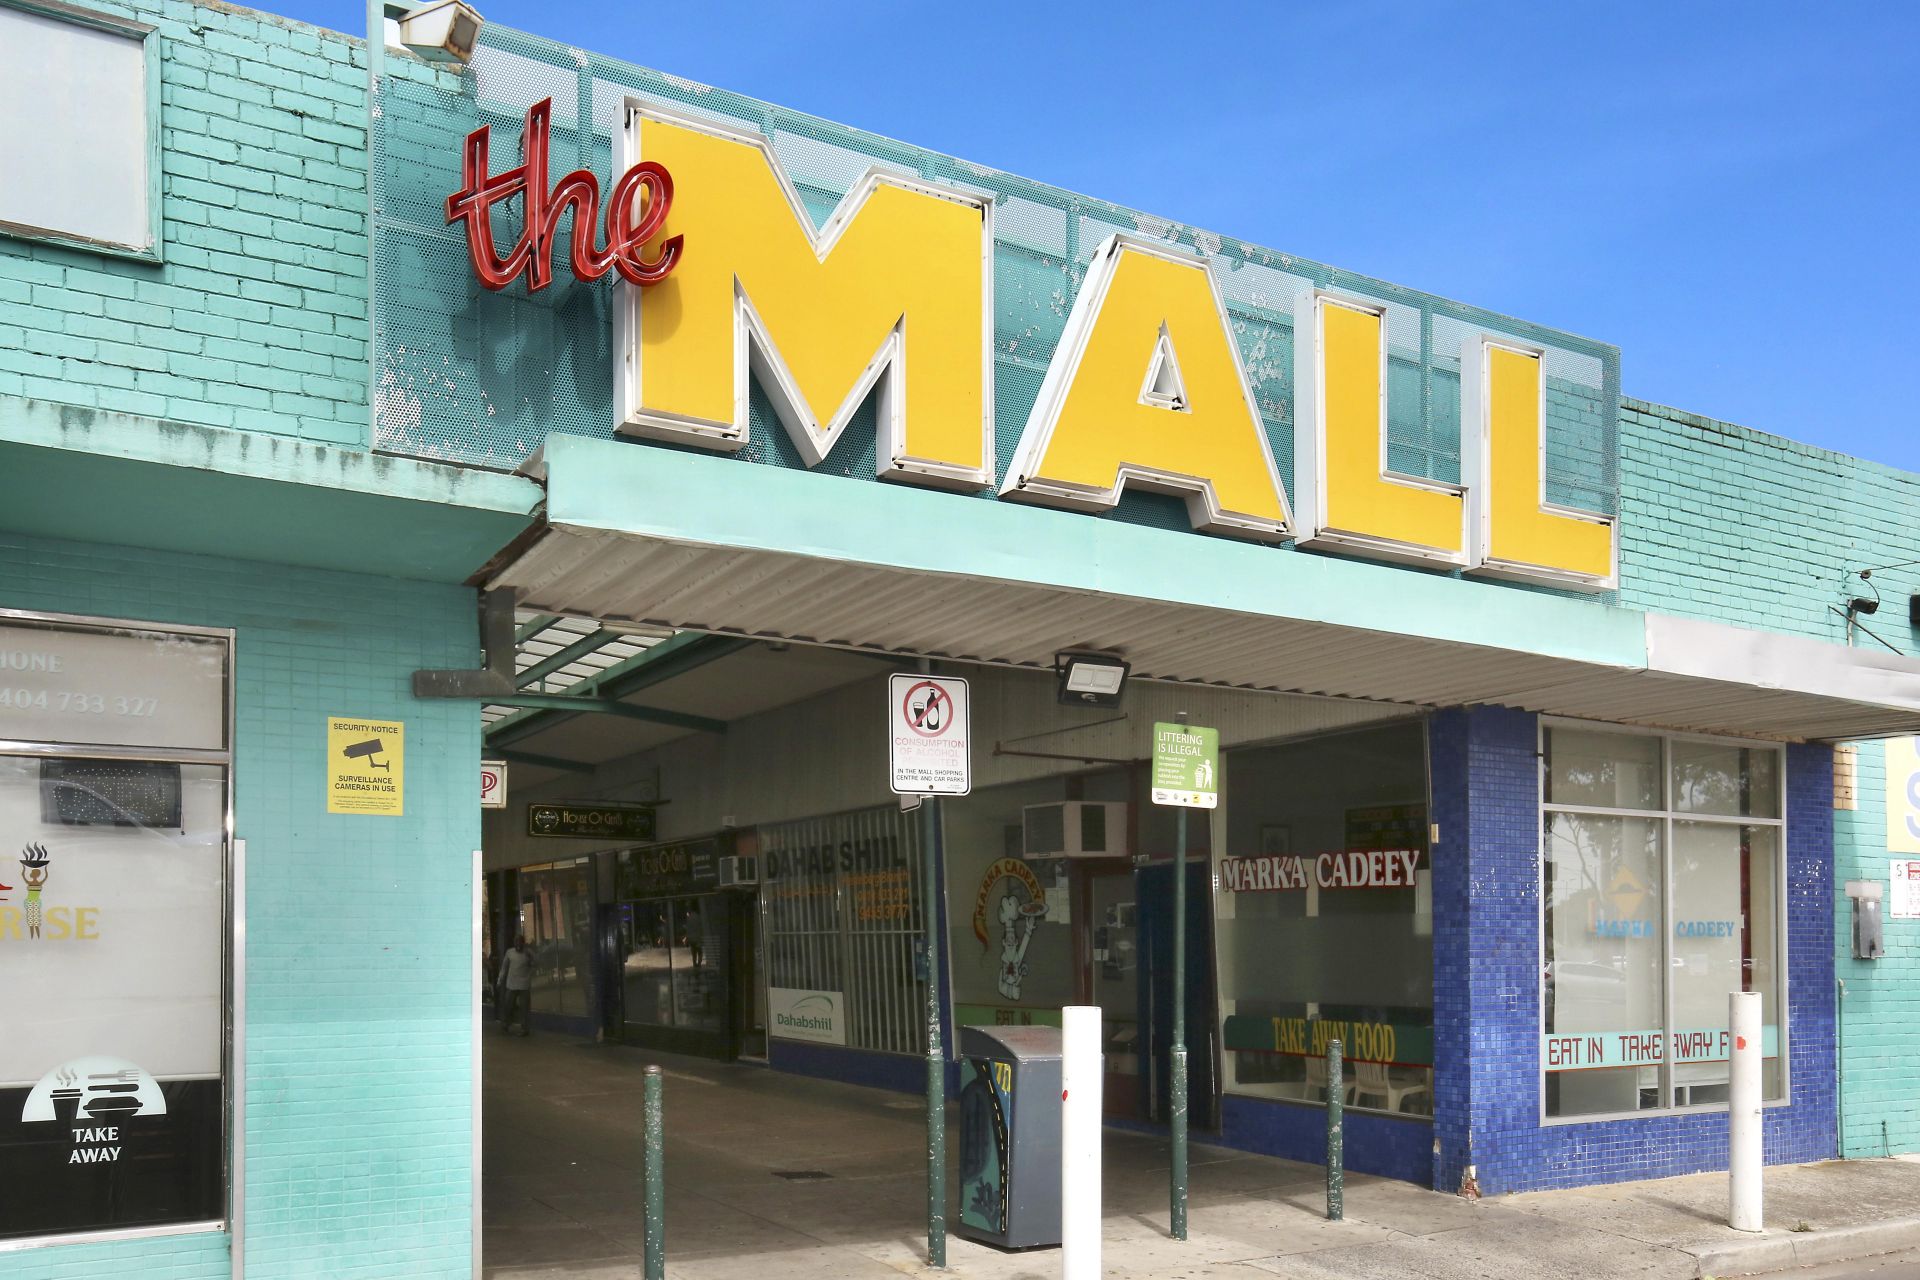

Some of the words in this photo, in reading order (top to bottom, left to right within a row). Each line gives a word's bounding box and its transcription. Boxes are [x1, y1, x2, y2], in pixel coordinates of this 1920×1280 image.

[445, 97, 684, 294] the
[613, 96, 1618, 591] MALL
[57, 692, 105, 714] 733
[114, 696, 161, 717] 327
[333, 723, 370, 732] SECURITY
[371, 726, 398, 734] NOTICE
[895, 737, 965, 749] CONSUMPTION
[1158, 731, 1203, 745] LITTERING
[1158, 743, 1166, 753] IS
[1168, 743, 1202, 757] ILLEGAL
[334, 783, 370, 791] CAMERAS
[338, 775, 392, 784] SURVEILLANCE
[1221, 855, 1309, 893] MARKA
[1316, 850, 1420, 889] CADEEY
[1676, 920, 1735, 938] CADEEY
[777, 1013, 832, 1031] Dahabshiil
[995, 1009, 1016, 1026] EAT
[1272, 1016, 1306, 1055] TAKE
[1353, 1022, 1396, 1063] FOOD
[1549, 1038, 1582, 1065] EAT
[1588, 1037, 1603, 1063] IN
[1619, 1034, 1662, 1061] TAKE
[72, 1126, 119, 1143] TAKE
[69, 1146, 121, 1164] AWAY
